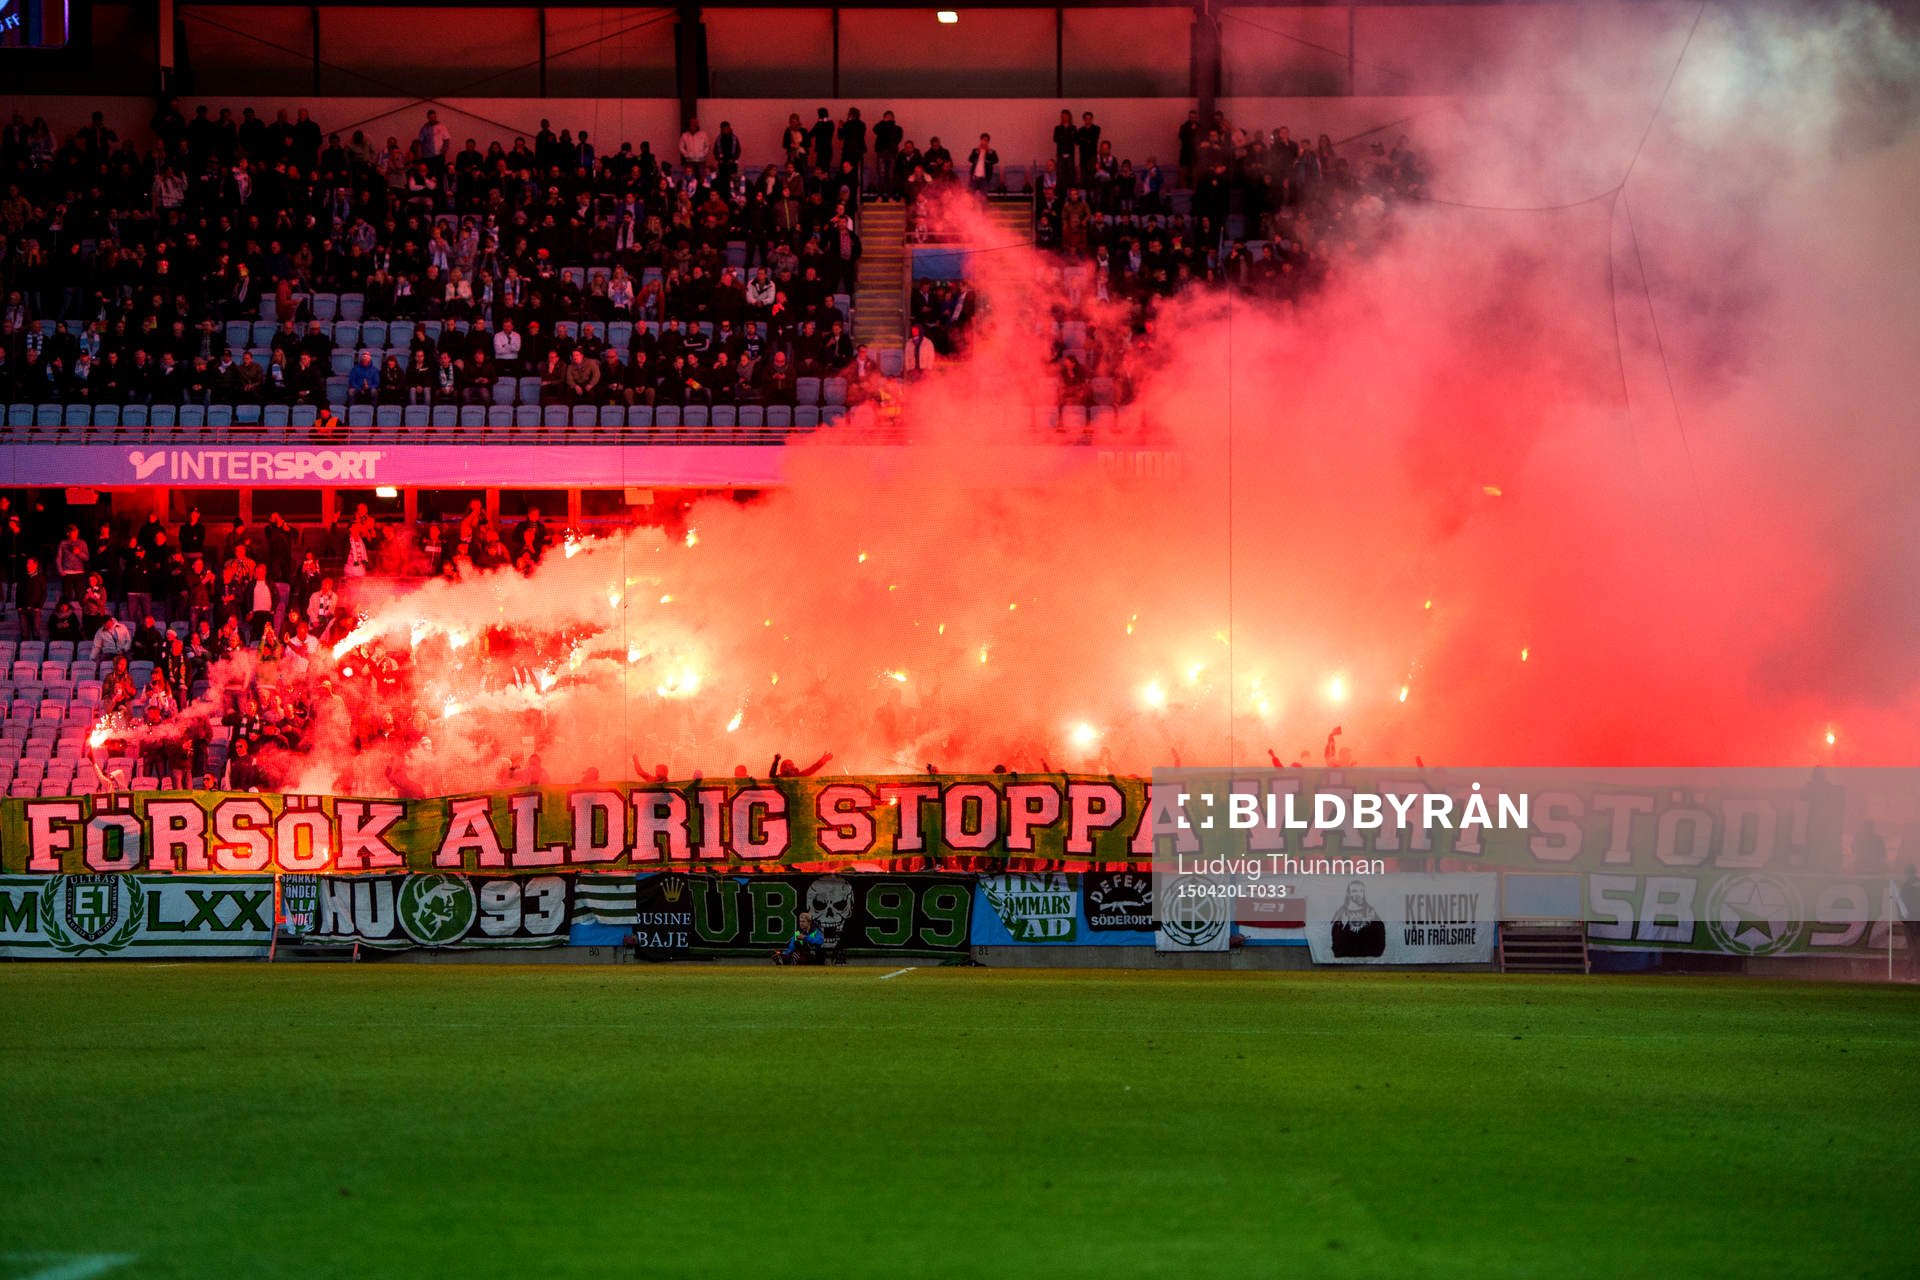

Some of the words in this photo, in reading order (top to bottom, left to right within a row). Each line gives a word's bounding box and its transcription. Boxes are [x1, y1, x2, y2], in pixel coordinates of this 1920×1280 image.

[171, 451, 381, 480] INTERSPORT
[24, 794, 408, 873] FÖRSÖK
[432, 785, 792, 869] ALDRIG
[815, 781, 1201, 856] STOPPA
[70, 874, 116, 884] ULTRAS
[284, 884, 317, 898] ÖNDER
[980, 872, 1071, 892] MINA
[1090, 874, 1155, 903] DEFEND
[75, 886, 110, 915] E1
[146, 890, 272, 933] LXX
[290, 899, 315, 911] LLA
[319, 878, 396, 938] HU
[480, 877, 566, 936] 93
[688, 879, 798, 944] UB
[865, 882, 972, 946] 99
[1004, 894, 1070, 915] ÖMMARS
[1405, 894, 1479, 925] KENNEDY
[1022, 919, 1071, 937] AD
[1091, 914, 1155, 926] SÖDERORT
[1404, 925, 1424, 946] VÅR
[1428, 925, 1477, 946] FRÄLSARE
